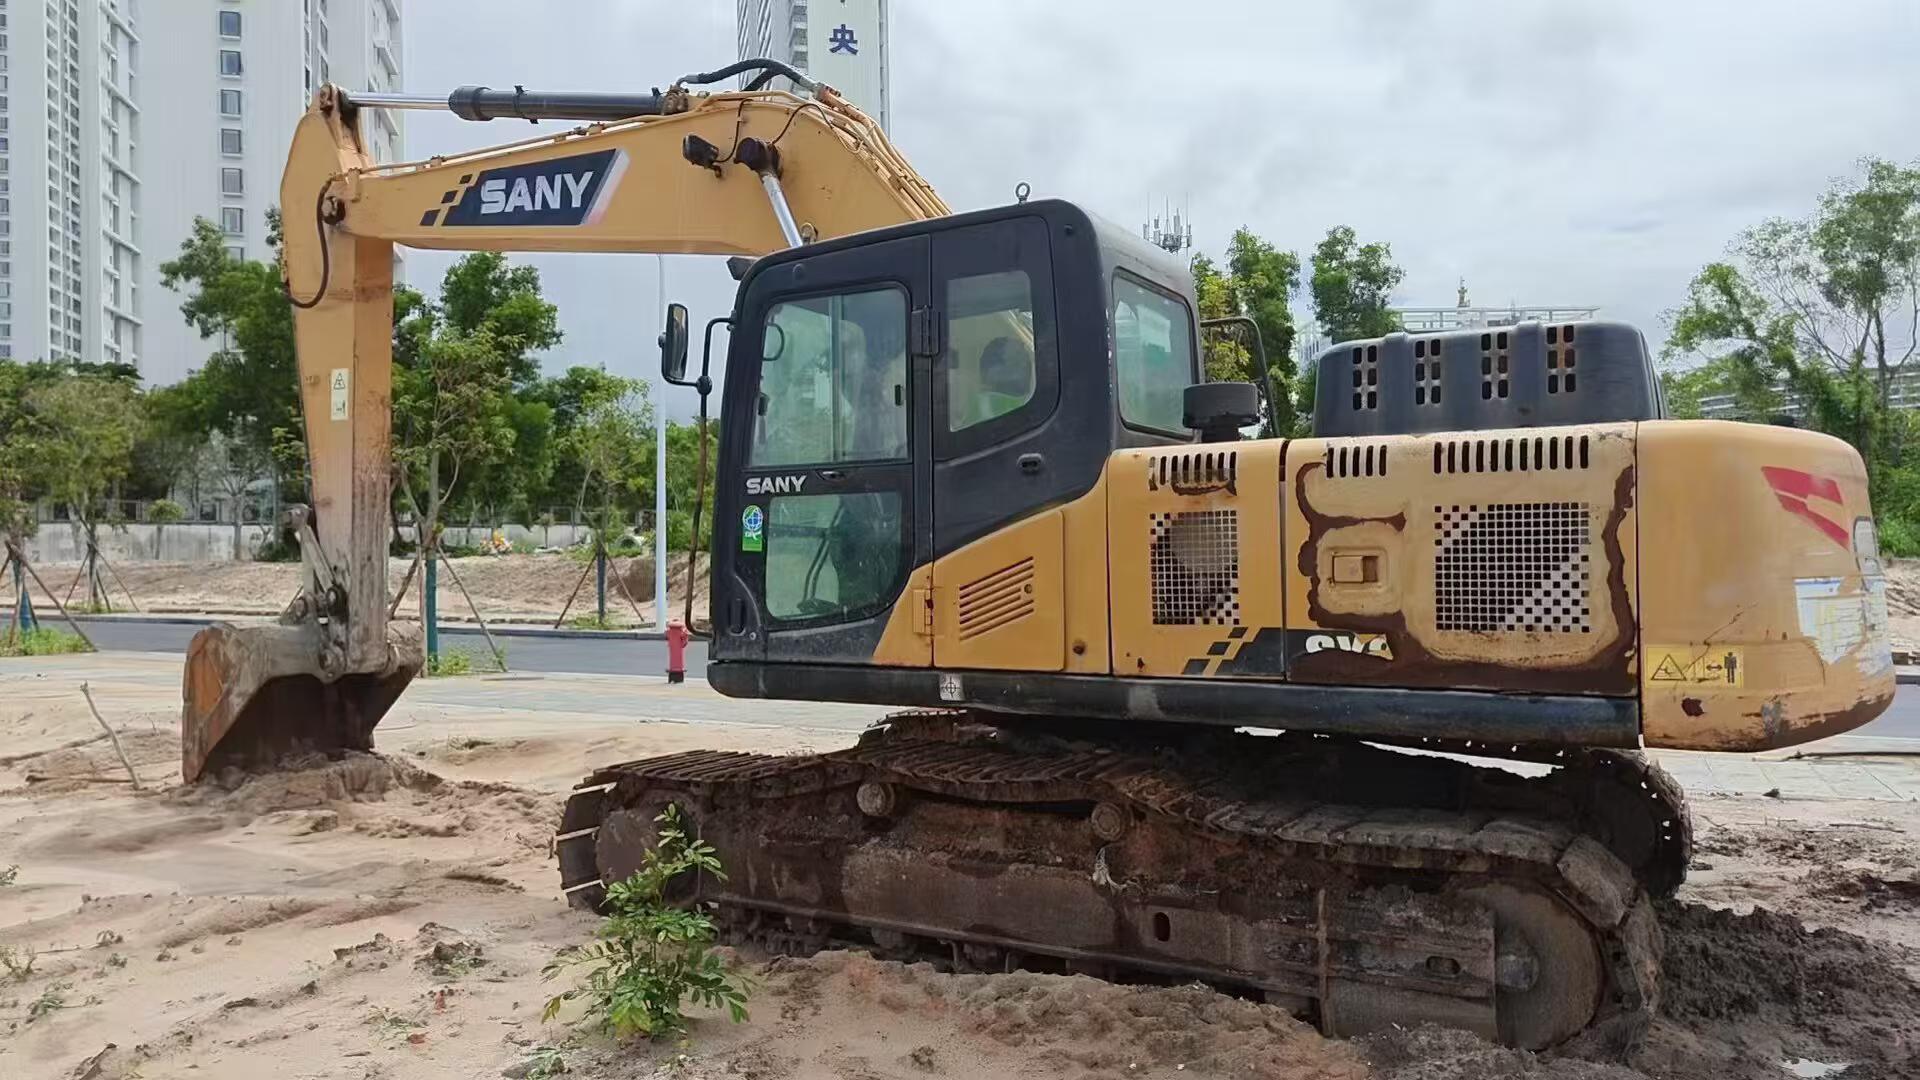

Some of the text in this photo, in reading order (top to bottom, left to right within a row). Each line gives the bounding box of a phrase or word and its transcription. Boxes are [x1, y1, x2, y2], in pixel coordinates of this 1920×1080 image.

[829, 24, 858, 55] 央
[480, 171, 594, 214] SANY
[746, 475, 807, 494] SANY
